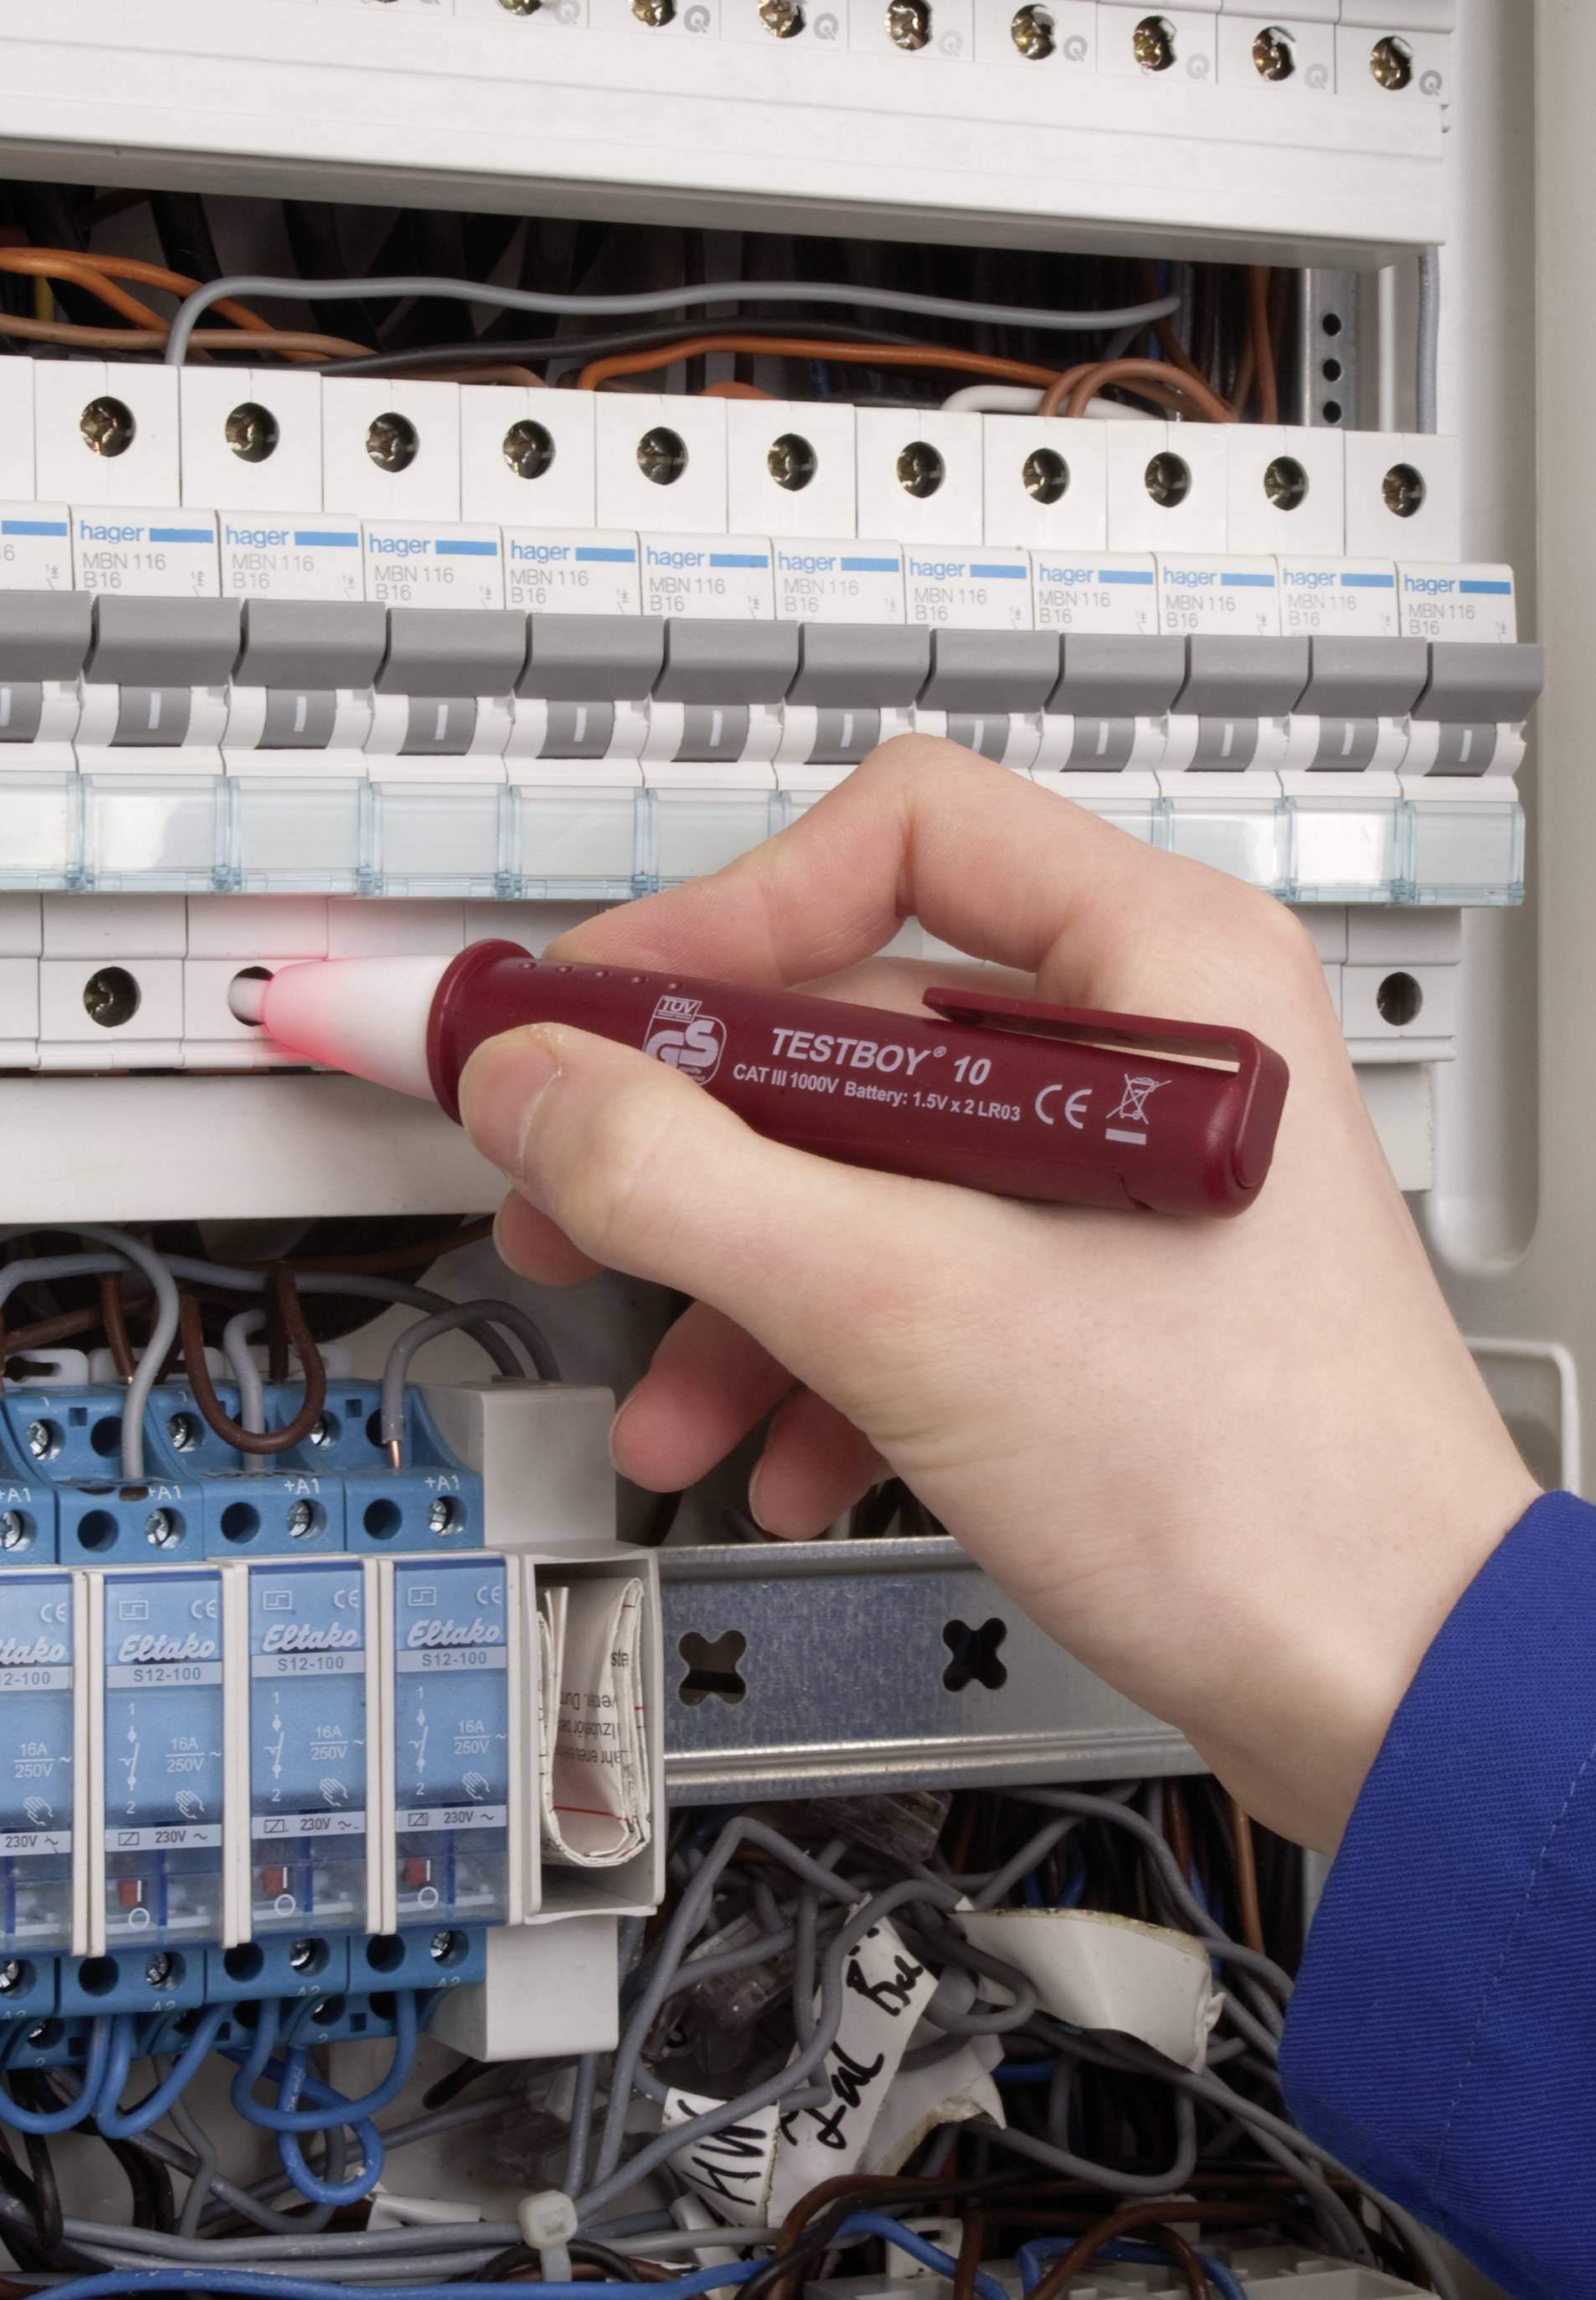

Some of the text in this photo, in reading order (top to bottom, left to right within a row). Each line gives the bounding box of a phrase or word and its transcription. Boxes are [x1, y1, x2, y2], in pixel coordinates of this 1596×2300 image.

[80, 520, 144, 543] hager
[225, 525, 289, 548] hager
[368, 533, 430, 556] hager
[510, 540, 570, 563] hager
[83, 553, 167, 571] MBN 116
[646, 548, 704, 569] hager
[777, 552, 836, 573] hager
[374, 565, 454, 584] MBN 116
[909, 558, 965, 579] hager
[1039, 563, 1094, 585] hager
[1164, 566, 1216, 587] hager
[1283, 567, 1337, 587] hager
[511, 569, 589, 587] MBN 116
[650, 577, 725, 595] MBN 116
[1404, 574, 1455, 595] hager
[1166, 594, 1236, 612] MBN 116
[1408, 603, 1475, 620] MBN 116
[953, 1055, 991, 1086] 10
[734, 1063, 1021, 1122] CAT III 1000V Battery: 1.5V x 2 LR03
[262, 1622, 358, 1653] Eltako
[407, 1618, 501, 1648] Eltako
[118, 1634, 215, 1664] Eltako
[277, 1656, 344, 1673] S12-100
[421, 1650, 487, 1667] S12-100
[133, 1667, 202, 1683] S12-100
[315, 1725, 342, 1739] 16A
[458, 1720, 484, 1735] 16A
[19, 1742, 48, 1757] 16A
[172, 1737, 198, 1751] 16A
[311, 1744, 348, 1760] 250V
[454, 1739, 490, 1755] 250V
[14, 1762, 53, 1778] 250V
[167, 1757, 204, 1773] 250V
[300, 1818, 331, 1833] 230V
[444, 1811, 474, 1825] 230V
[5, 1834, 37, 1849] 230V
[155, 1829, 186, 1845] 230V
